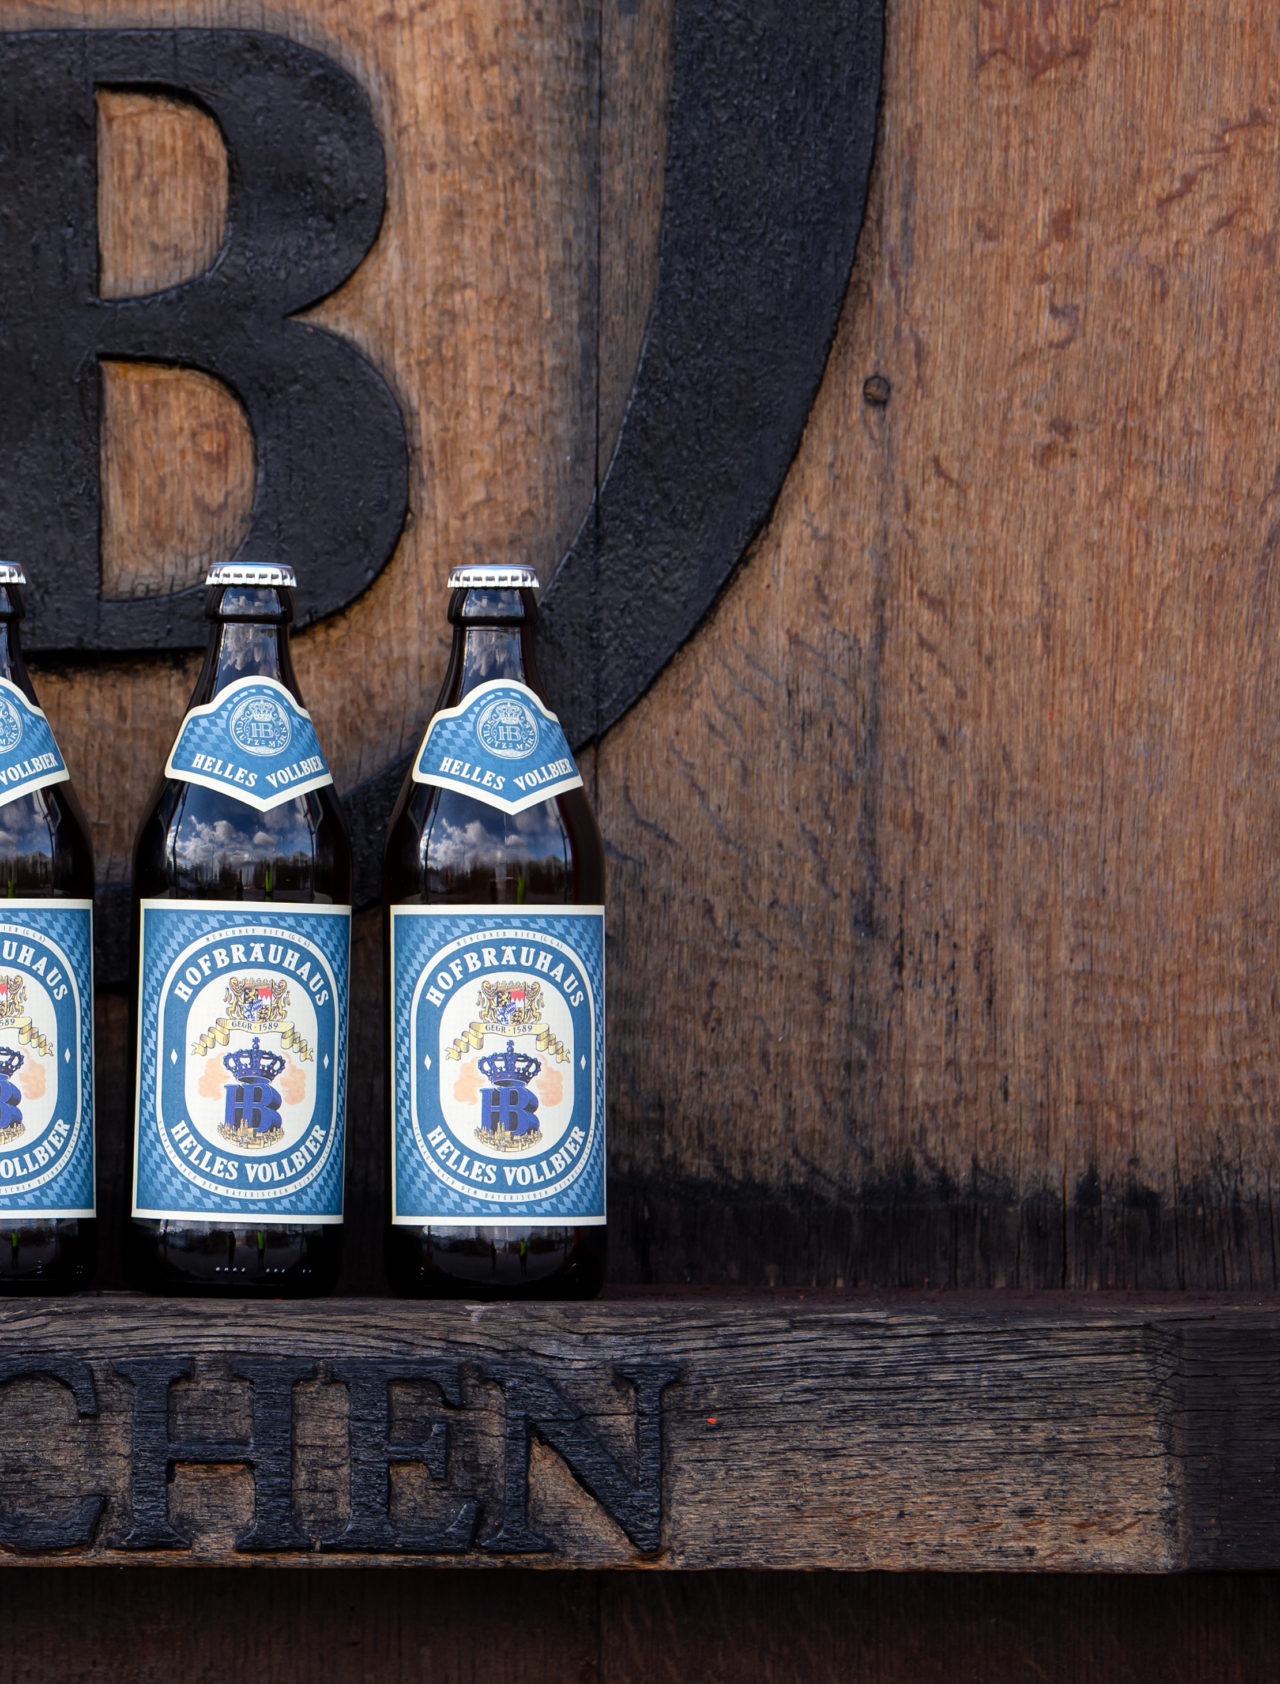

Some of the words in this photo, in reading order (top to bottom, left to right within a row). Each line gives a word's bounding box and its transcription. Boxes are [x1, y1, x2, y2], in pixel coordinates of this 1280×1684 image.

[251, 722, 274, 738] HB
[498, 725, 520, 741] HB
[191, 753, 258, 787] HELLES
[265, 755, 324, 788] VOLLBIER
[439, 756, 506, 790] HELLES
[513, 758, 573, 791] VOLLBIER
[173, 942, 329, 1007] HOFBRÄUHAUS
[425, 945, 584, 1008] HOFBRÄUHAUS
[258, 1022, 279, 1031] 1589
[512, 1025, 533, 1034] 1589
[170, 1120, 238, 1180] HELLES
[245, 1124, 327, 1183] VOLLBIER
[426, 1125, 497, 1184] HELLES
[503, 1126, 586, 1186] VOLLBIER
